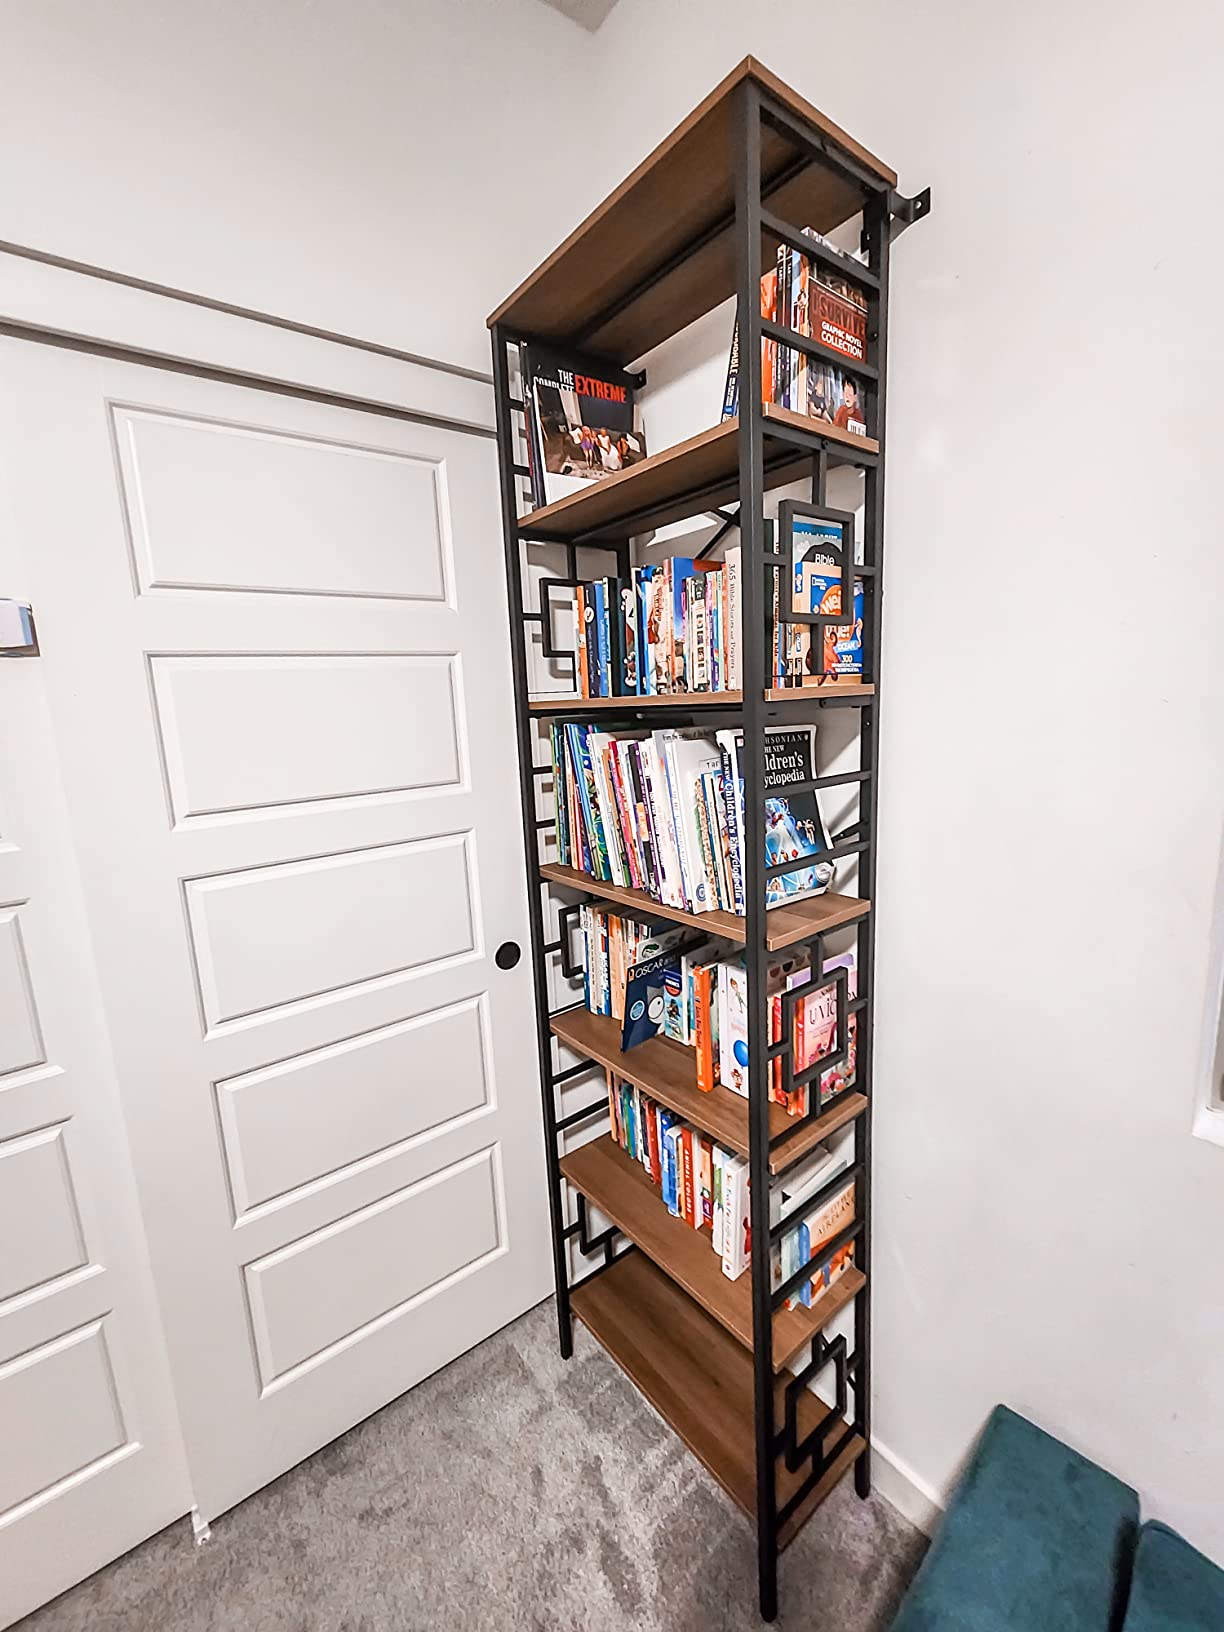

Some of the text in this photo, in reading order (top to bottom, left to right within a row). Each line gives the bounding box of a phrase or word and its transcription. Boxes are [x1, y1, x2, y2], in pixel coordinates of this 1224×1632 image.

[821, 321, 863, 349] GRAPHIC NOVEL
[821, 330, 863, 359] COLLECTION
[558, 369, 626, 404] THE EXTREME
[814, 553, 835, 567] Bible
[728, 563, 736, 581] 365
[841, 654, 853, 663] 300
[764, 751, 804, 771] ldren's
[724, 765, 732, 781] NEW
[764, 768, 805, 789] yclopedia
[725, 782, 736, 834] Children's
[730, 836, 743, 899] Encyclopedia
[635, 959, 664, 979] OSCAR
